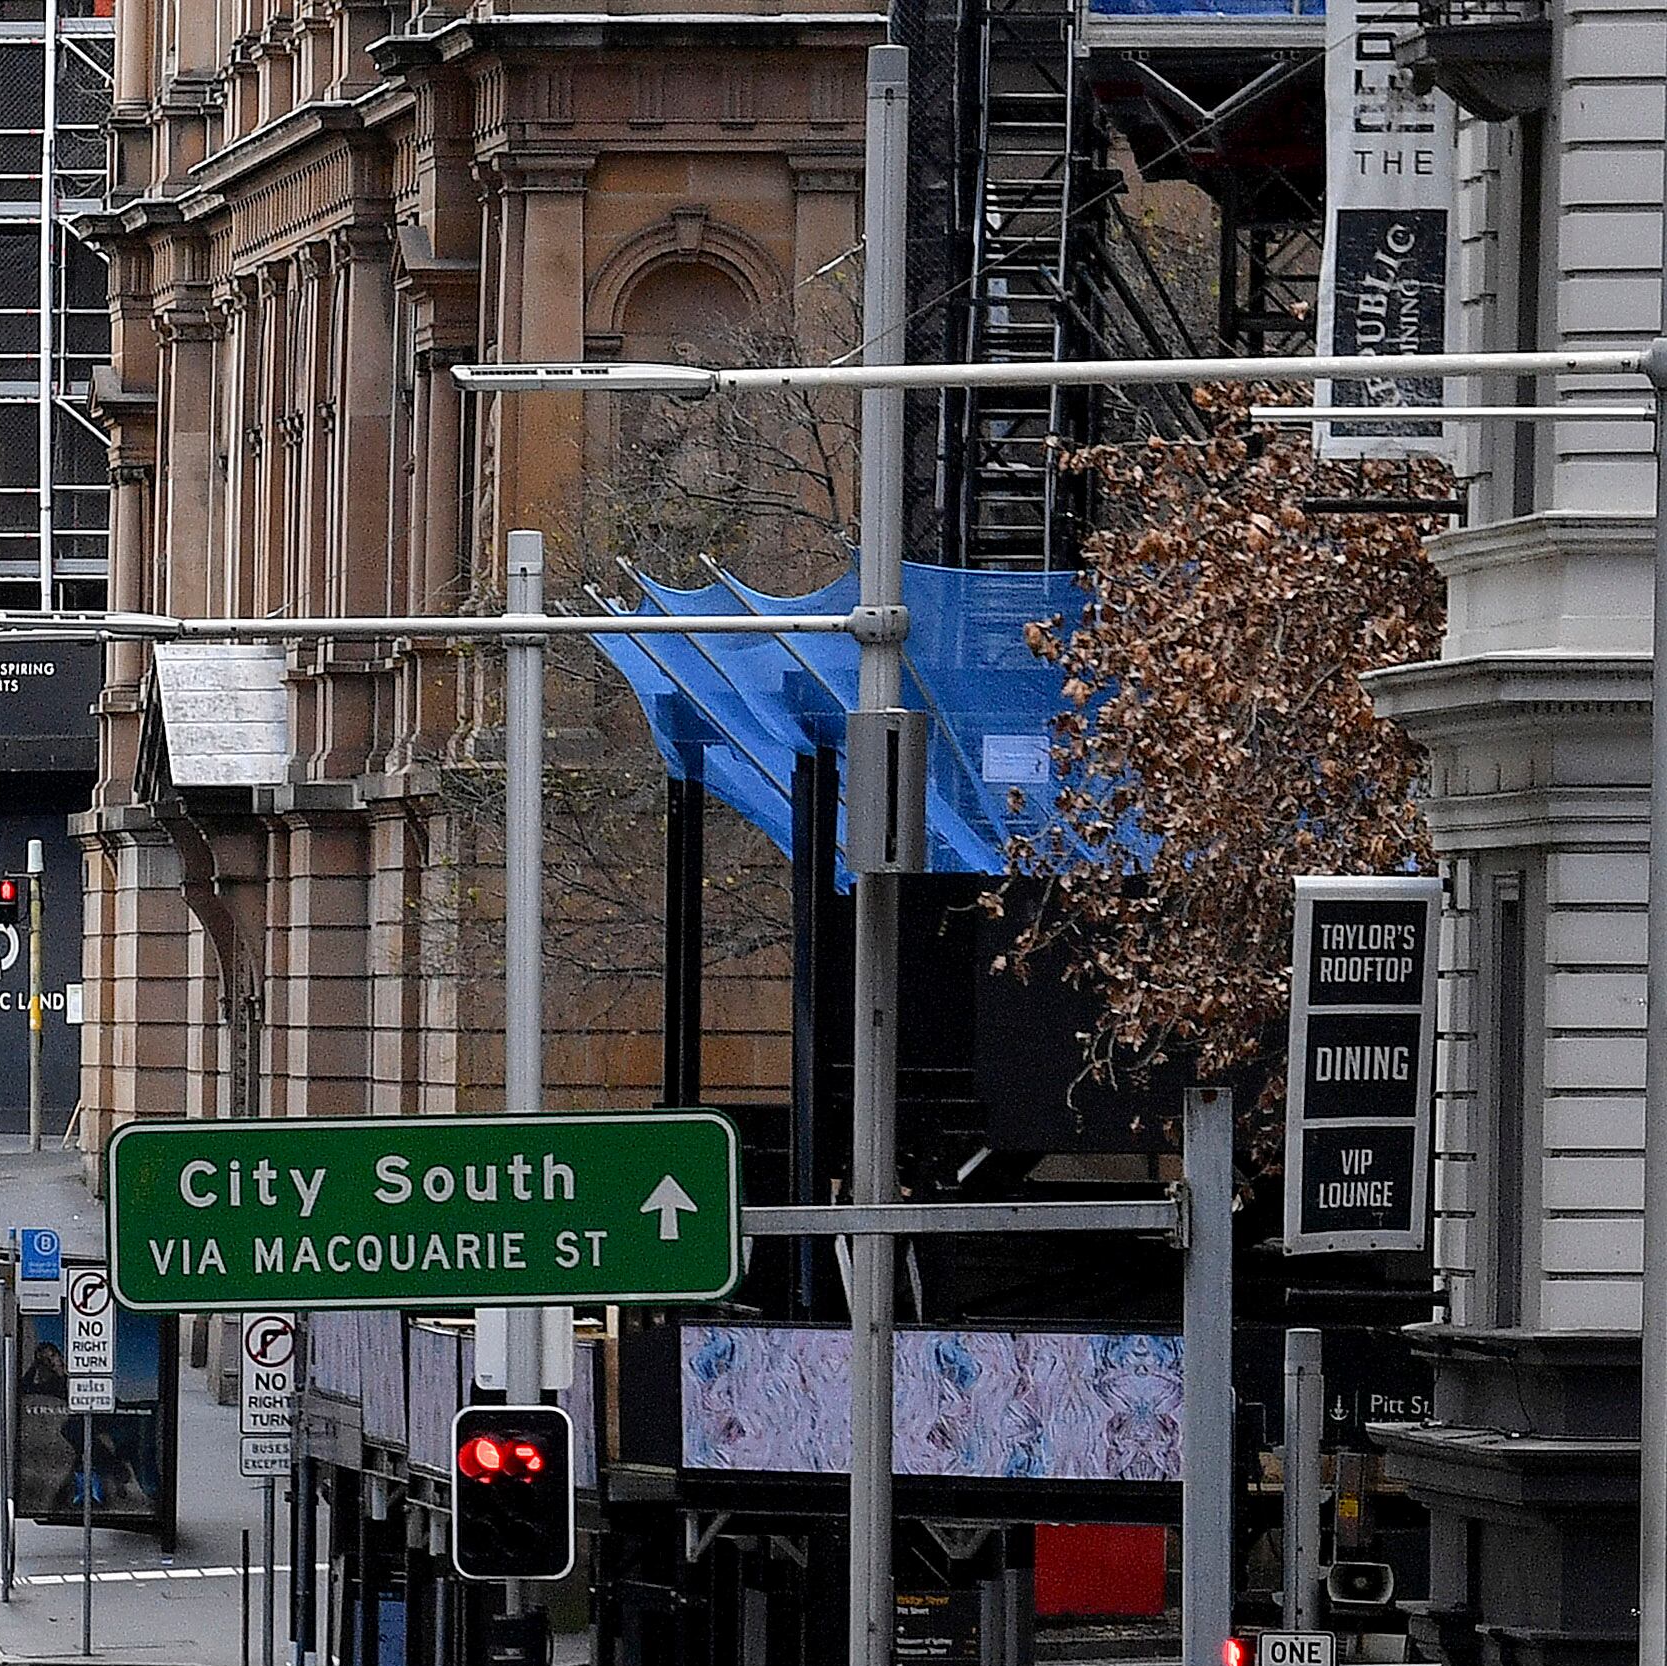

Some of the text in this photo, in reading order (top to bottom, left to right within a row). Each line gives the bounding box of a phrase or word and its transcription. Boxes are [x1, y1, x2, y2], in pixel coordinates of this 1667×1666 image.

[1354, 150, 1434, 175] THE
[1399, 278, 1420, 356] INING
[1320, 923, 1415, 951] TAYLOR'S
[1320, 956, 1413, 983] ROOFTOP
[1316, 1046, 1409, 1082] DINING
[1341, 1149, 1373, 1175] VIP
[179, 1153, 576, 1218] City South
[1319, 1181, 1394, 1209] LOUNGE
[149, 1230, 608, 1276] VIA MACQUARIE ST
[78, 1321, 103, 1337] NO
[72, 1341, 107, 1352] RIGHT
[74, 1356, 107, 1367] TURN
[255, 1373, 287, 1391] NO
[248, 1396, 292, 1408] RIGHT
[1371, 1394, 1405, 1414] Pitt
[250, 1414, 292, 1427] TURN
[244, 1459, 289, 1469] EXCEPTE
[1271, 1641, 1322, 1663] ONE
